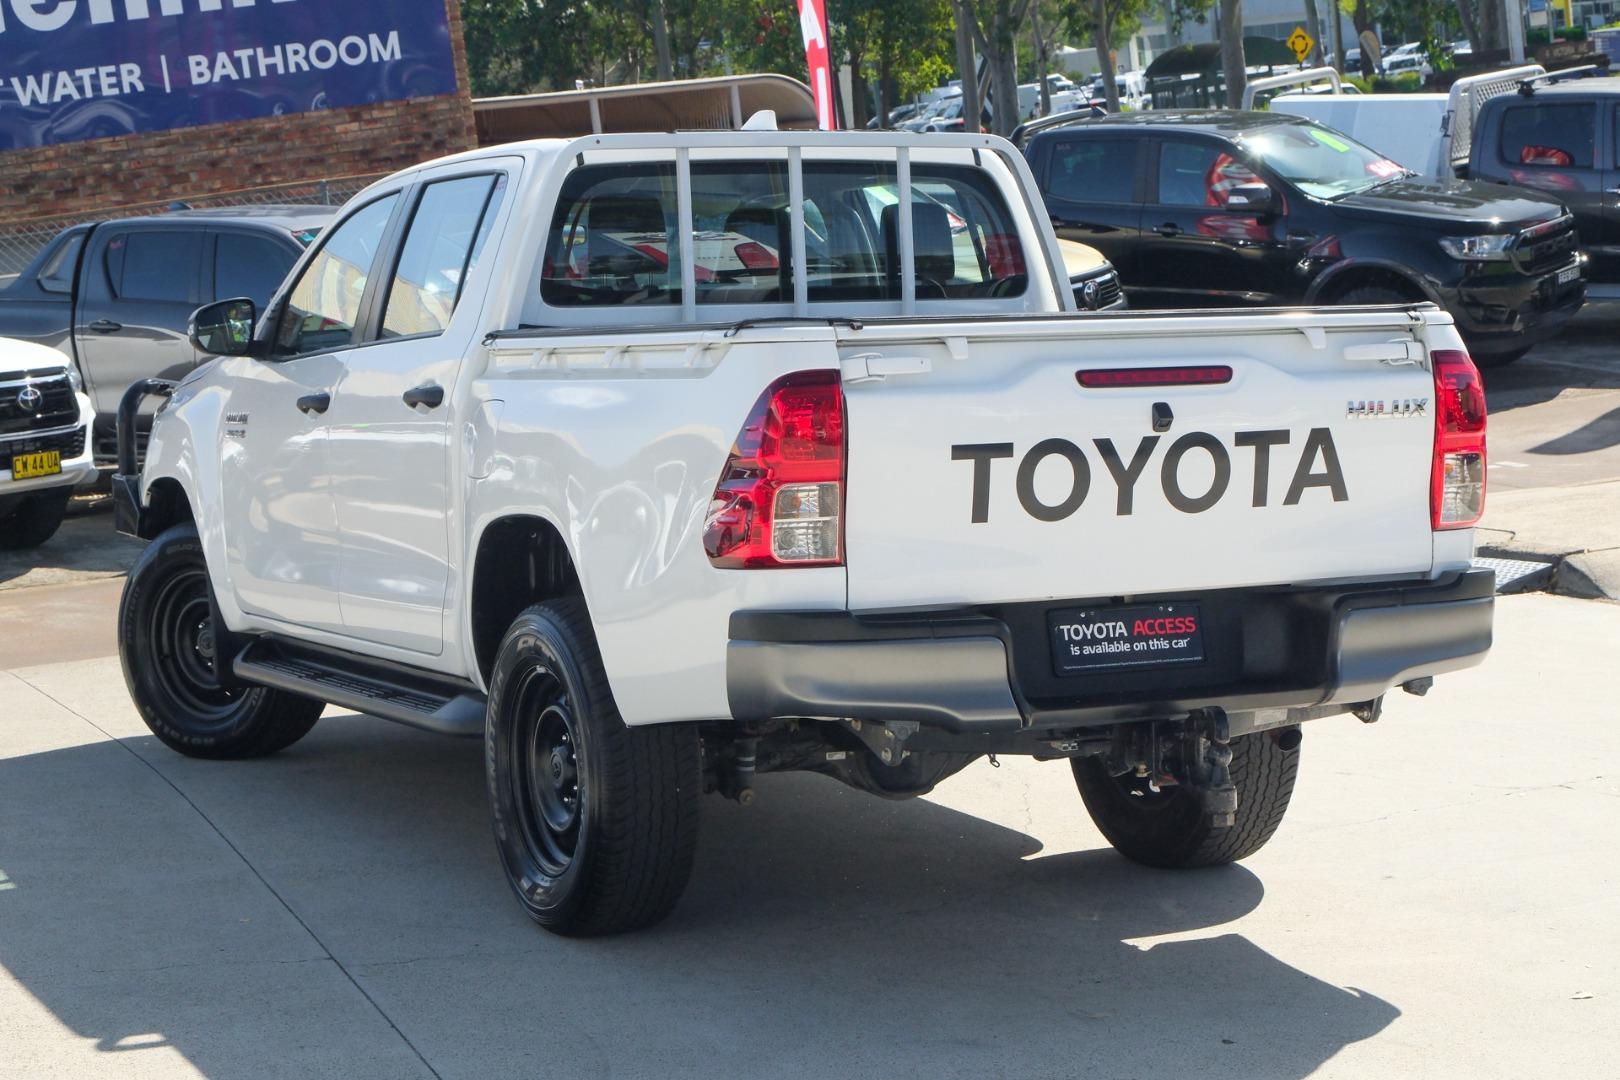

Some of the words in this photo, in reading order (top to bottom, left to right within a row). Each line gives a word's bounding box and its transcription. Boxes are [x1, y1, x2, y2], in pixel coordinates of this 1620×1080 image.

[11, 63, 144, 107] WATER
[188, 31, 401, 86] BATHROOM
[951, 427, 1349, 523] TOYOTA
[1060, 621, 1128, 641] TOYOTA
[1133, 617, 1196, 636] ACCESS
[1070, 643, 1080, 655] is
[1083, 640, 1131, 655] available
[1133, 640, 1147, 651] on
[1149, 637, 1169, 650] this
